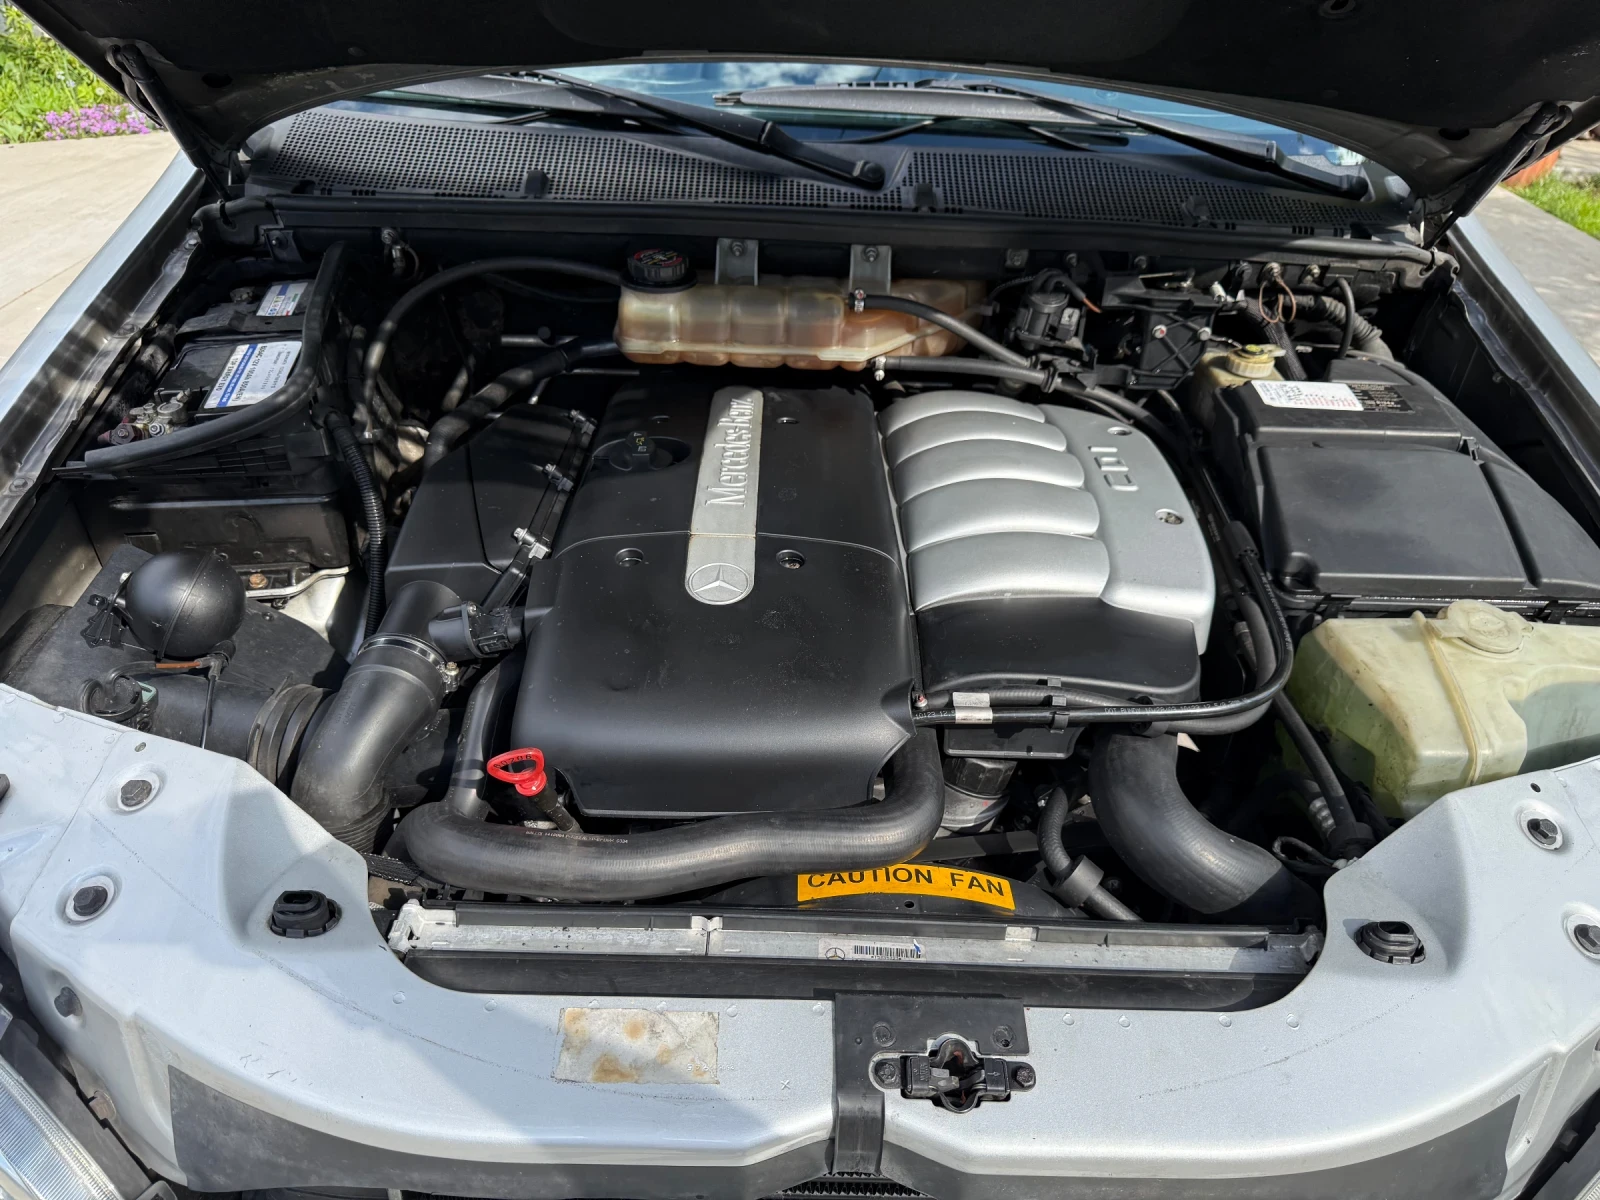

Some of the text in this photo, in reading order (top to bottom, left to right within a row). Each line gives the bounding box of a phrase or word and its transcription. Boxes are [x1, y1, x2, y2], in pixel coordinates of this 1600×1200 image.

[705, 397, 754, 508] Mercedes-Benz
[1088, 445, 1139, 492] CDI
[807, 866, 1005, 897] CAUTION FAN
